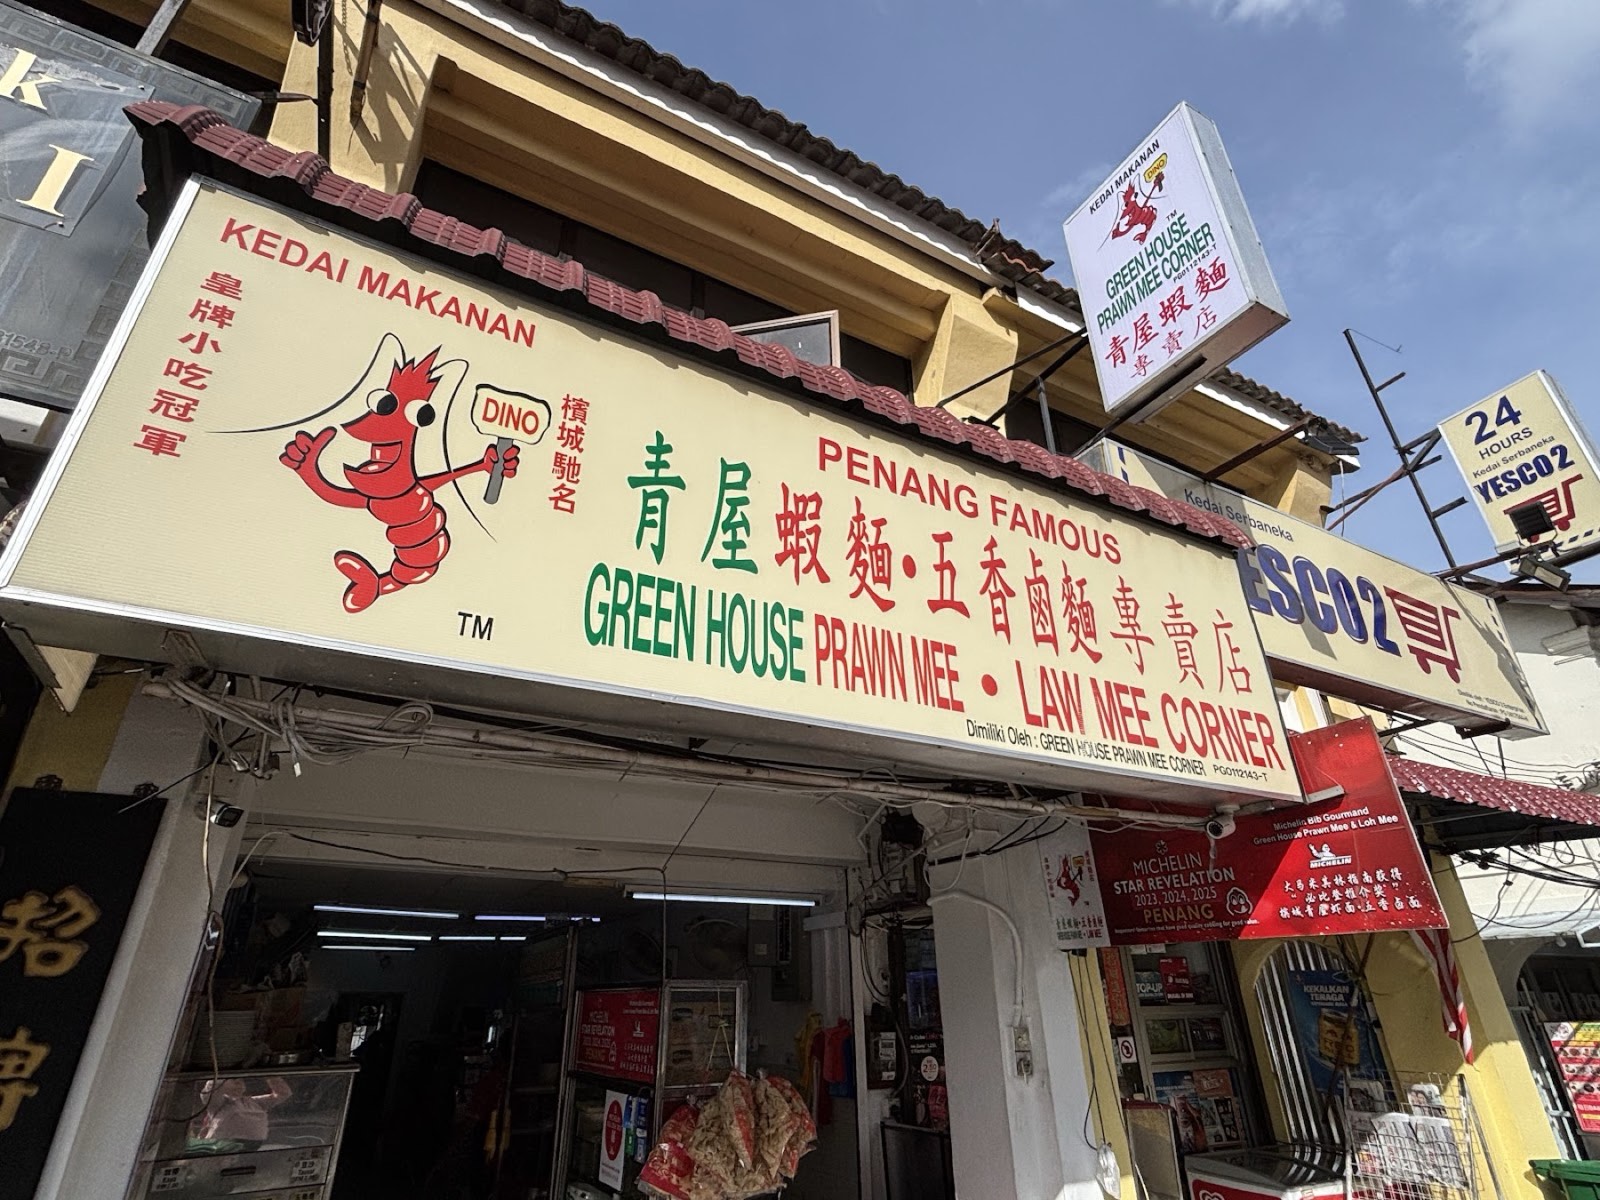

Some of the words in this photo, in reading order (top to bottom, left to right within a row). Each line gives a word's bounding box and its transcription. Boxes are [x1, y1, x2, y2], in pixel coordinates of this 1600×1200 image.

[1089, 182, 1115, 215] KEDAI
[1115, 138, 1161, 187] MAKANAN
[1146, 159, 1166, 181] DINO
[1097, 288, 1141, 335] PRAWN
[1136, 271, 1163, 303] MEE
[1161, 222, 1215, 281] CORNER
[1106, 255, 1147, 300] GREEN
[1146, 213, 1190, 263] HOUSE
[220, 217, 349, 285] KEDAI
[357, 269, 537, 349] MAKANAN
[133, 271, 243, 459] 皇牌小吃冠軍
[482, 397, 540, 437] DINO
[1465, 394, 1522, 445] 24
[548, 393, 590, 515] 檳城馳名
[1472, 462, 1501, 479] Kedai
[1501, 434, 1556, 466] Serbaneka
[1479, 426, 1533, 460] HOURS
[1473, 444, 1575, 504] YESCO2
[819, 436, 979, 519] PENANG
[990, 494, 1122, 565] FAMOUS
[1184, 488, 1224, 517] Kedai
[1225, 503, 1294, 543] Serbaneka
[1237, 543, 1402, 658] ESCO2
[457, 611, 494, 641] TM
[584, 561, 697, 662] GREEN
[705, 589, 806, 683] HOUSE
[814, 613, 908, 702] PRAWN
[910, 635, 965, 712] MEE
[1015, 660, 1086, 735] LAW
[1089, 676, 1159, 749] MEE
[1160, 692, 1286, 771] CORNER
[966, 719, 1006, 743] Dimiliki
[1007, 729, 1032, 749] Oleh
[1040, 734, 1076, 755] GREEN
[1076, 740, 1112, 762] HOUSE
[1113, 747, 1148, 767] PRAWN
[1149, 753, 1169, 770] MEE
[1169, 756, 1207, 777] CORNER
[1253, 835, 1277, 845] Green
[1277, 831, 1303, 842] House
[1303, 826, 1330, 838] Prawn
[1330, 823, 1349, 833] Mee
[1350, 820, 1357, 829] &
[1359, 816, 1377, 828] Loh
[1377, 814, 1399, 825] Mee
[1273, 819, 1306, 831] Michelin
[1307, 813, 1322, 825] Bib
[1322, 806, 1370, 821] Gourmand
[1113, 879, 1145, 895] STAR
[1148, 866, 1236, 891] REVELATION
[1133, 852, 1203, 876] MICHELIN
[1309, 857, 1352, 869] MICHELIN
[1135, 894, 1162, 907] 2023,
[1162, 890, 1191, 904] 2024,
[1191, 886, 1218, 900] 2025
[1143, 903, 1214, 924] PENANG
[1303, 985, 1350, 993] KEKALKAN
